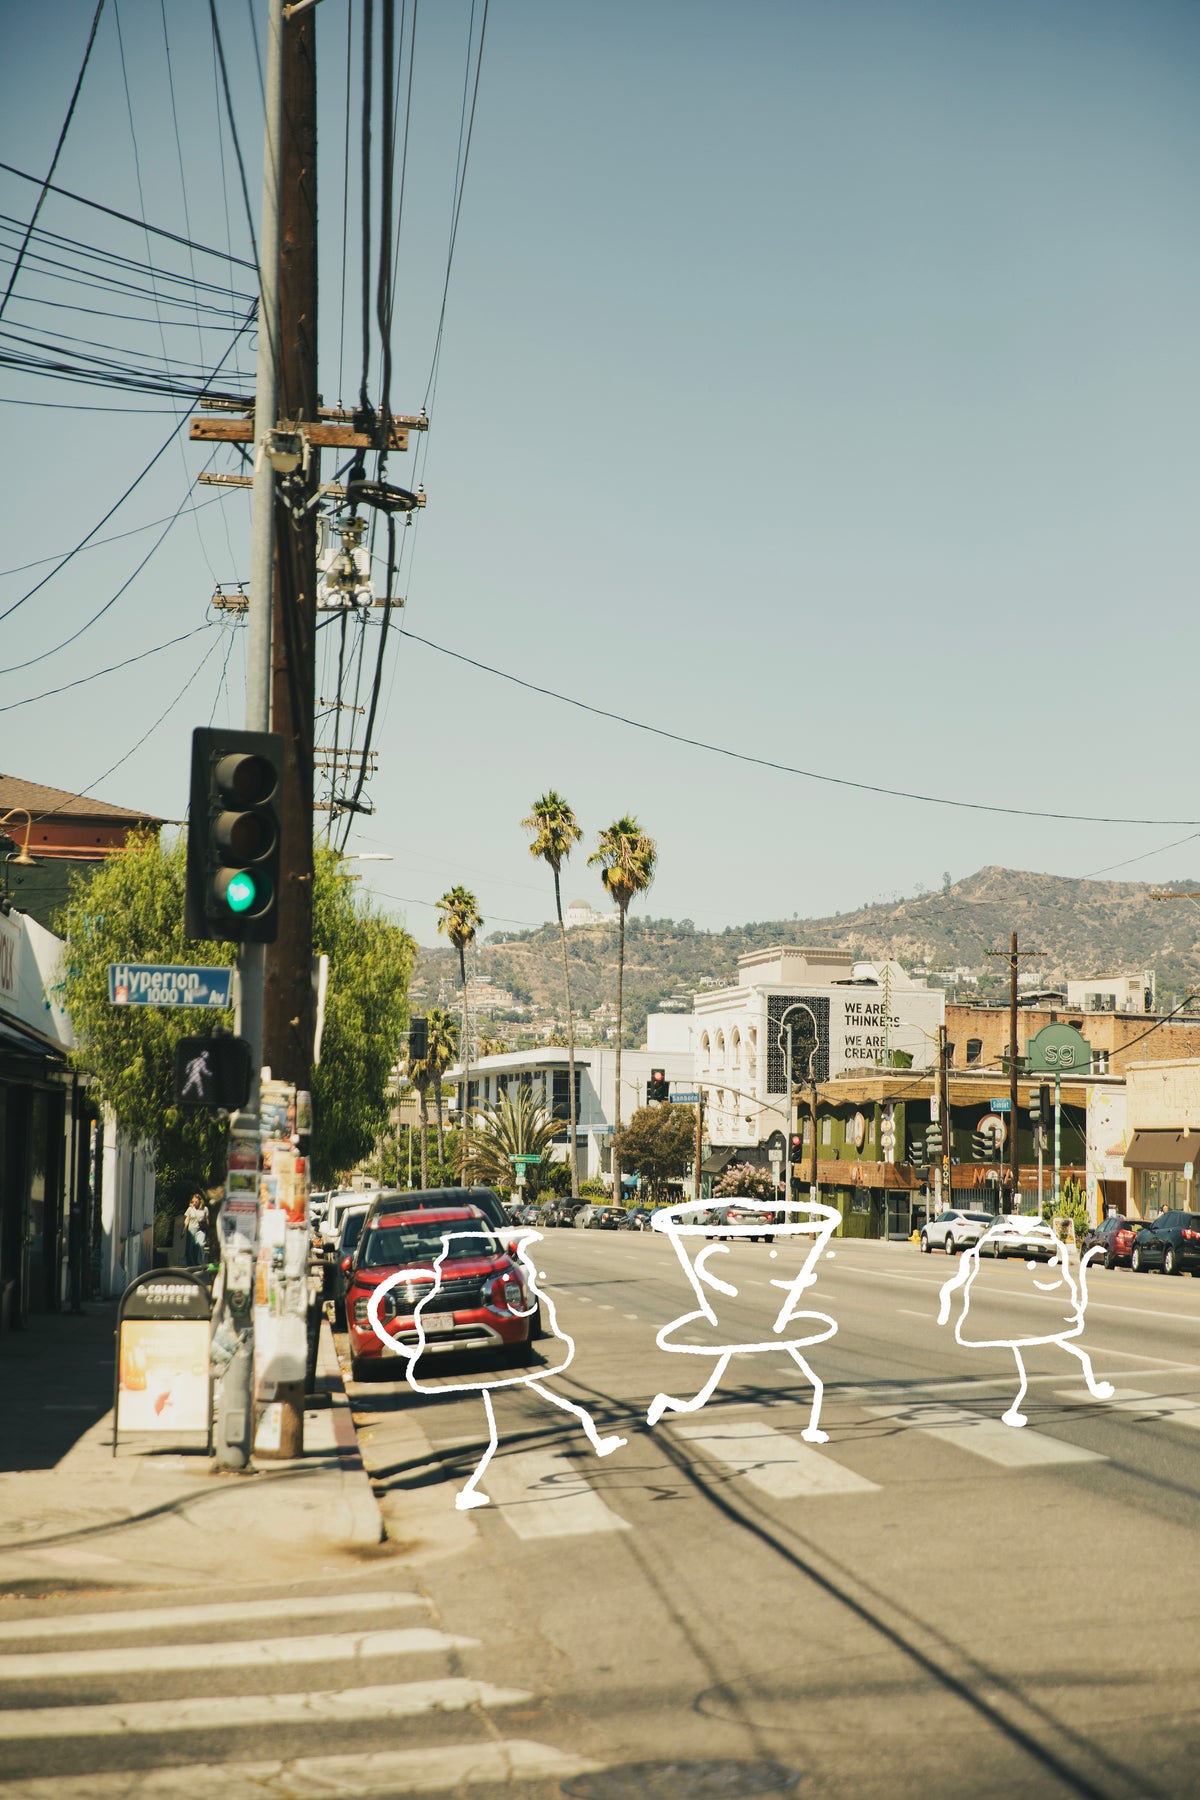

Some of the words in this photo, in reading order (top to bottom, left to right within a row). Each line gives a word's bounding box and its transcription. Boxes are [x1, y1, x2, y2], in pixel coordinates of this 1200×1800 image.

[115, 966, 199, 993] Hyperion
[147, 987, 178, 1003] 1000
[184, 988, 194, 1003] N
[209, 989, 225, 1004] Av
[844, 1002, 862, 1014] WE
[865, 1003, 887, 1014] ARE
[844, 1015, 900, 1028] THINKERS
[844, 1035, 862, 1046] WE
[865, 1036, 886, 1047] ARE
[1045, 1044, 1076, 1067] sg
[672, 1095, 699, 1103] Sanborn
[146, 1295, 190, 1305] COFFEE
